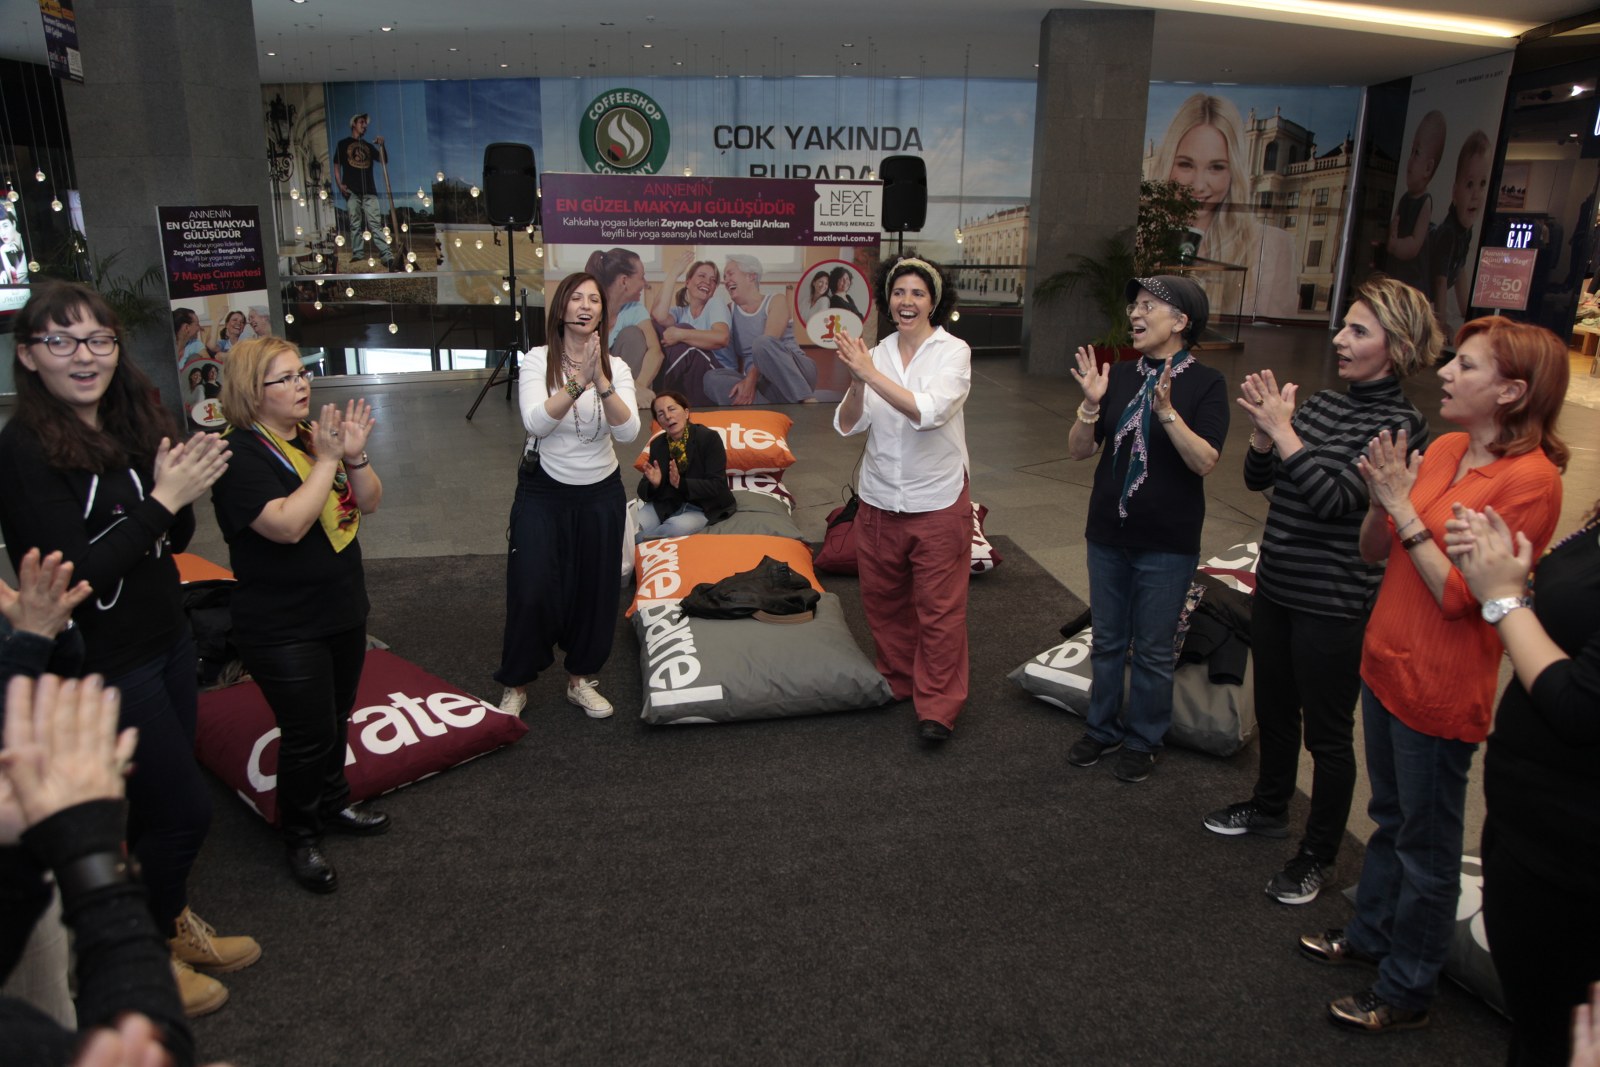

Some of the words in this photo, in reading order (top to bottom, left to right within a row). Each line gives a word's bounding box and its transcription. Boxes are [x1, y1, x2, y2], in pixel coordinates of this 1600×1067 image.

[589, 92, 662, 120] COFFEESHOP
[713, 125, 775, 155] ÇOK
[784, 125, 923, 151] YAKINDA
[830, 190, 872, 203] NEXT
[556, 198, 578, 213] EN
[581, 195, 631, 213] GÜZEL
[634, 199, 702, 214] MAKYAJI
[704, 198, 796, 217] GÜLÜŞÜDÜR
[820, 203, 875, 217] LEVEL
[188, 208, 232, 219] ANNENİN
[166, 221, 180, 230] EN
[181, 219, 213, 230] GÜZEL
[213, 219, 255, 229] MAKYAJI
[563, 217, 599, 226] Kahkaha
[629, 218, 660, 227] liderleri
[661, 218, 694, 230] Zeynep
[695, 218, 718, 228] Ocak
[730, 219, 760, 230] Bengül
[1510, 222, 1533, 230] baby
[183, 229, 242, 241] GÜLÜŞÜDÜR
[601, 228, 625, 239] keyifli
[626, 228, 638, 238] bir
[639, 231, 660, 240] yoga
[699, 230, 718, 239] Next
[813, 234, 875, 242] nextlevel.com.tr
[1507, 230, 1533, 248] GAP
[173, 272, 180, 281] 7
[182, 271, 212, 282] Mayıs
[212, 267, 262, 279] Cumartesi
[193, 282, 217, 292] Saat:
